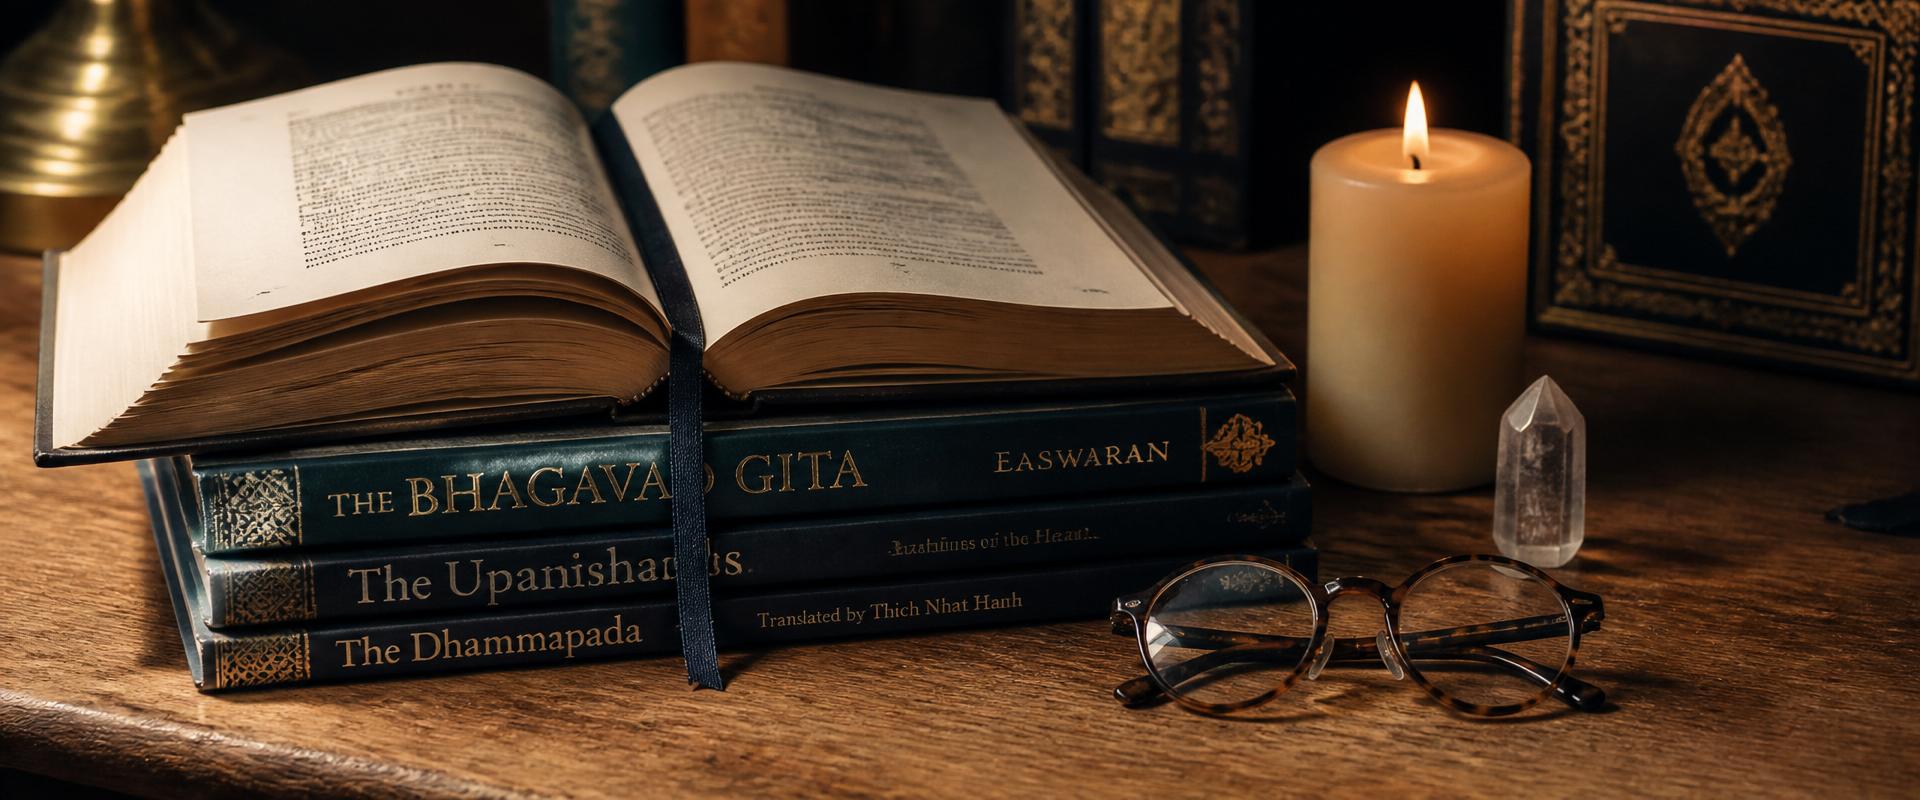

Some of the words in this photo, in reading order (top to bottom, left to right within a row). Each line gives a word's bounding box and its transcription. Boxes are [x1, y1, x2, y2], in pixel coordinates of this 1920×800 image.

[993, 440, 1171, 474] EASWARAN
[327, 490, 395, 518] THE
[735, 448, 868, 494] GITA
[347, 565, 432, 604] The
[756, 608, 841, 629] Translated
[846, 606, 866, 625] by
[870, 601, 921, 621] Thich
[925, 597, 969, 616] Nhat
[973, 591, 1024, 612] Hanh
[335, 637, 401, 669] The
[411, 615, 643, 662] Dhammapada
